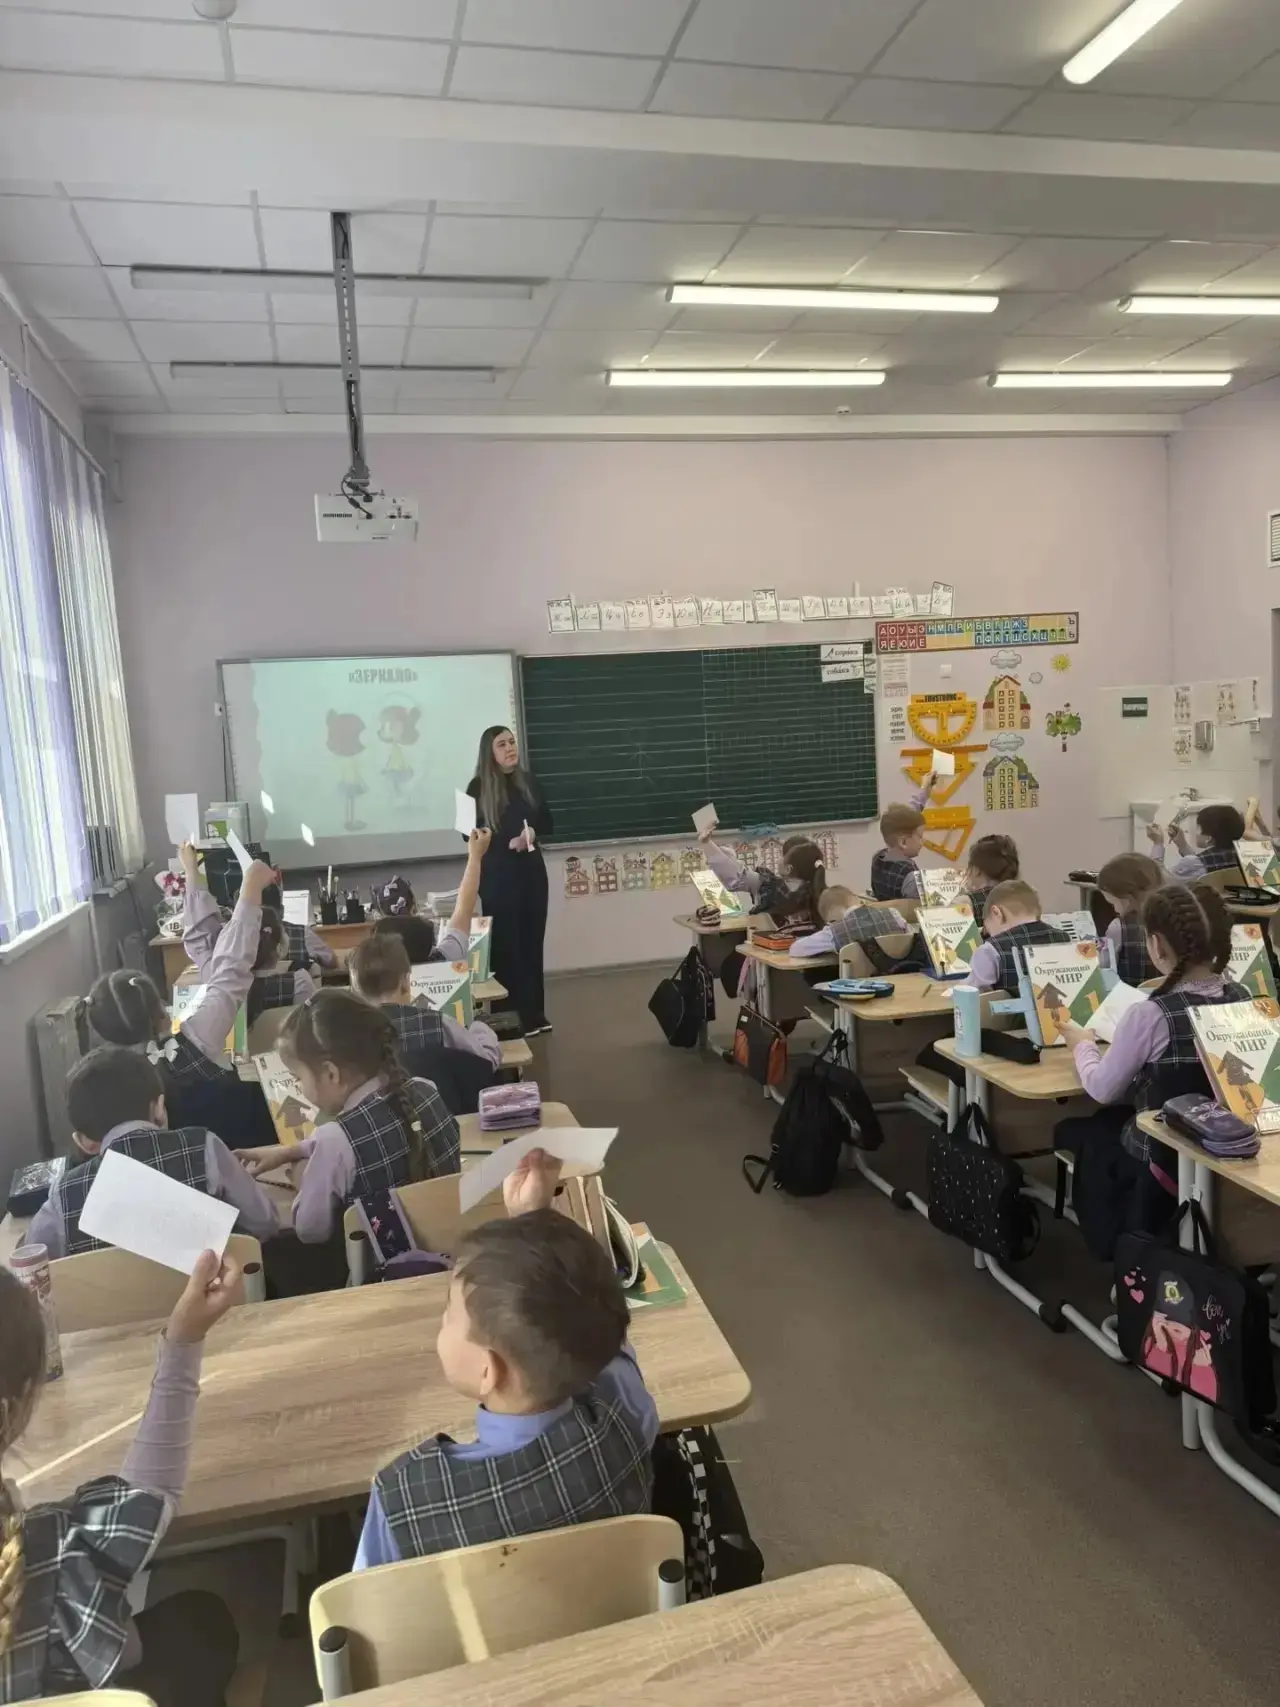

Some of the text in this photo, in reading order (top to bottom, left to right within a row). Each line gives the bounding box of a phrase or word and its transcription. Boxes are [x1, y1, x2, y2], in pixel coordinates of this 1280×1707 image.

[941, 925, 964, 935] МИР
[1034, 964, 1091, 976] Окружающий
[410, 978, 462, 988] Окружающий
[1055, 973, 1083, 985] МИР
[428, 984, 454, 995] МИР
[1233, 1038, 1267, 1053] МИР
